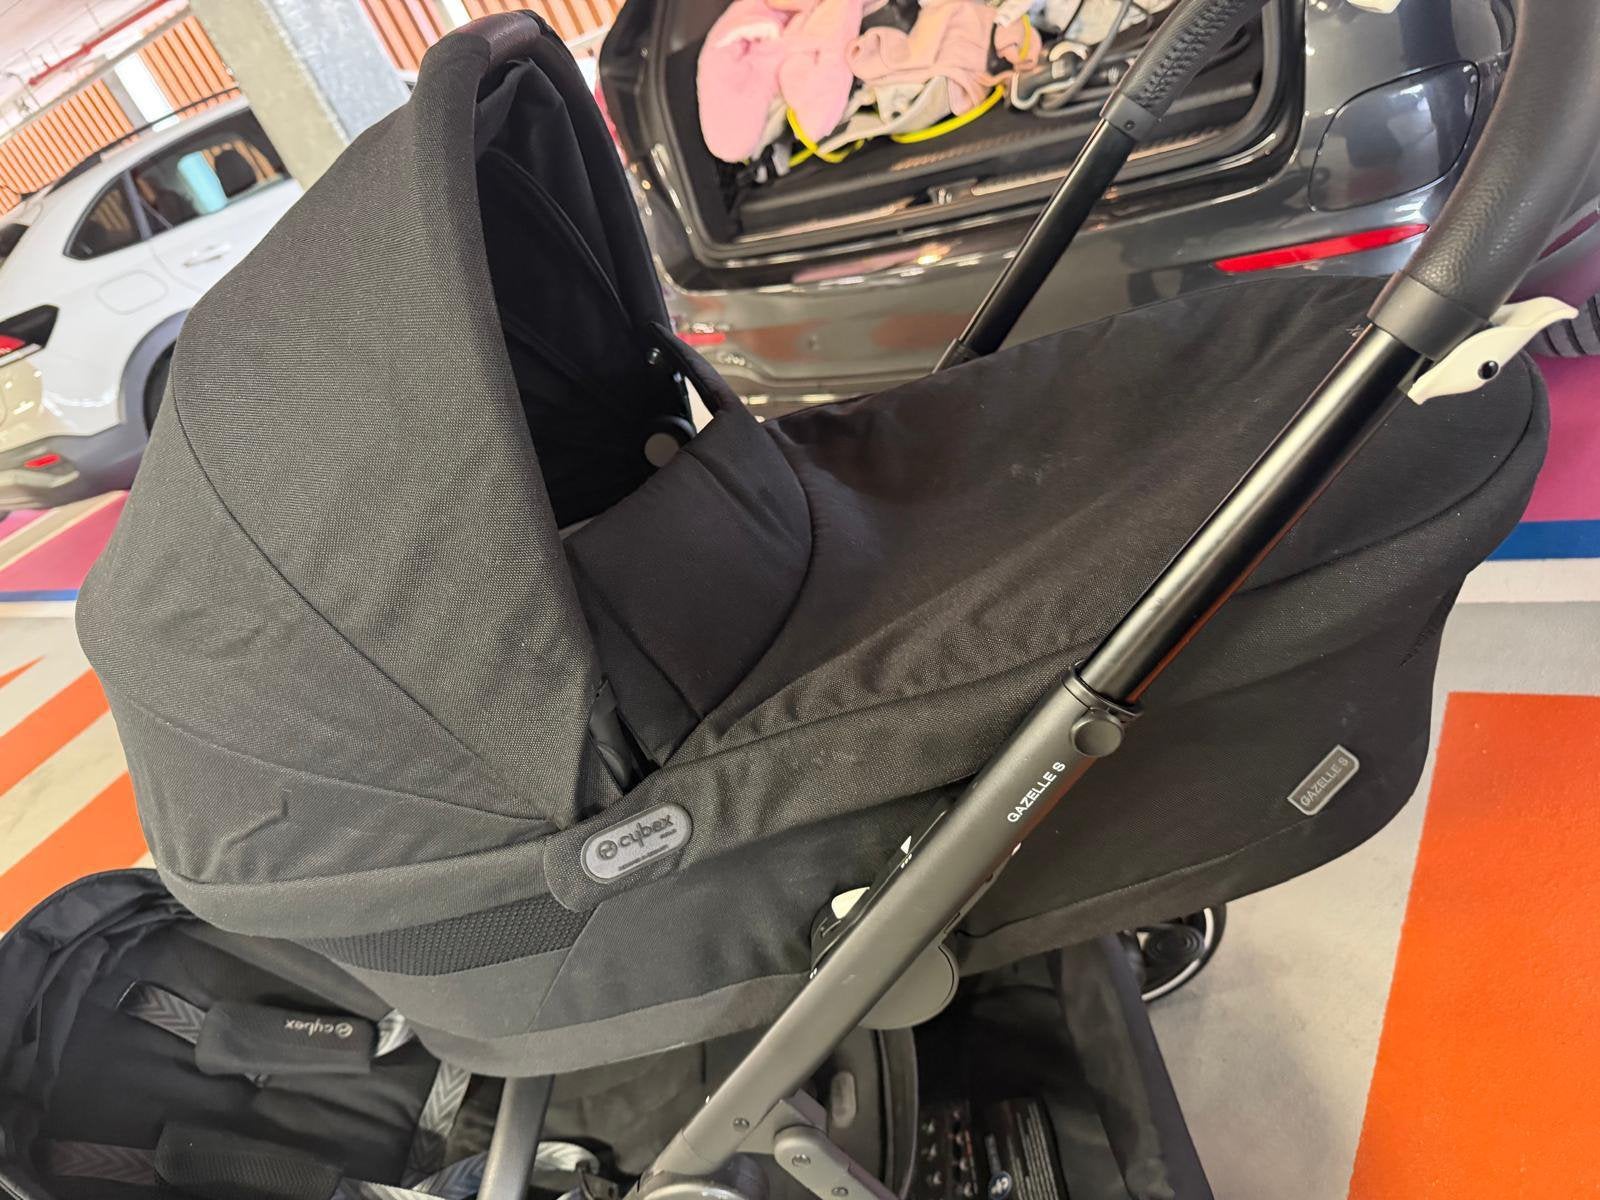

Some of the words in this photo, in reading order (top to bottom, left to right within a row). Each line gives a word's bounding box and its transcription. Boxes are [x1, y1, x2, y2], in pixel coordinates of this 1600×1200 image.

[1007, 771, 1057, 822] GAZELLE
[1052, 761, 1066, 772] S
[1300, 763, 1343, 806] GAZELLE
[1338, 756, 1349, 767] S
[619, 814, 674, 848] cybex
[284, 1018, 334, 1037] cybex
